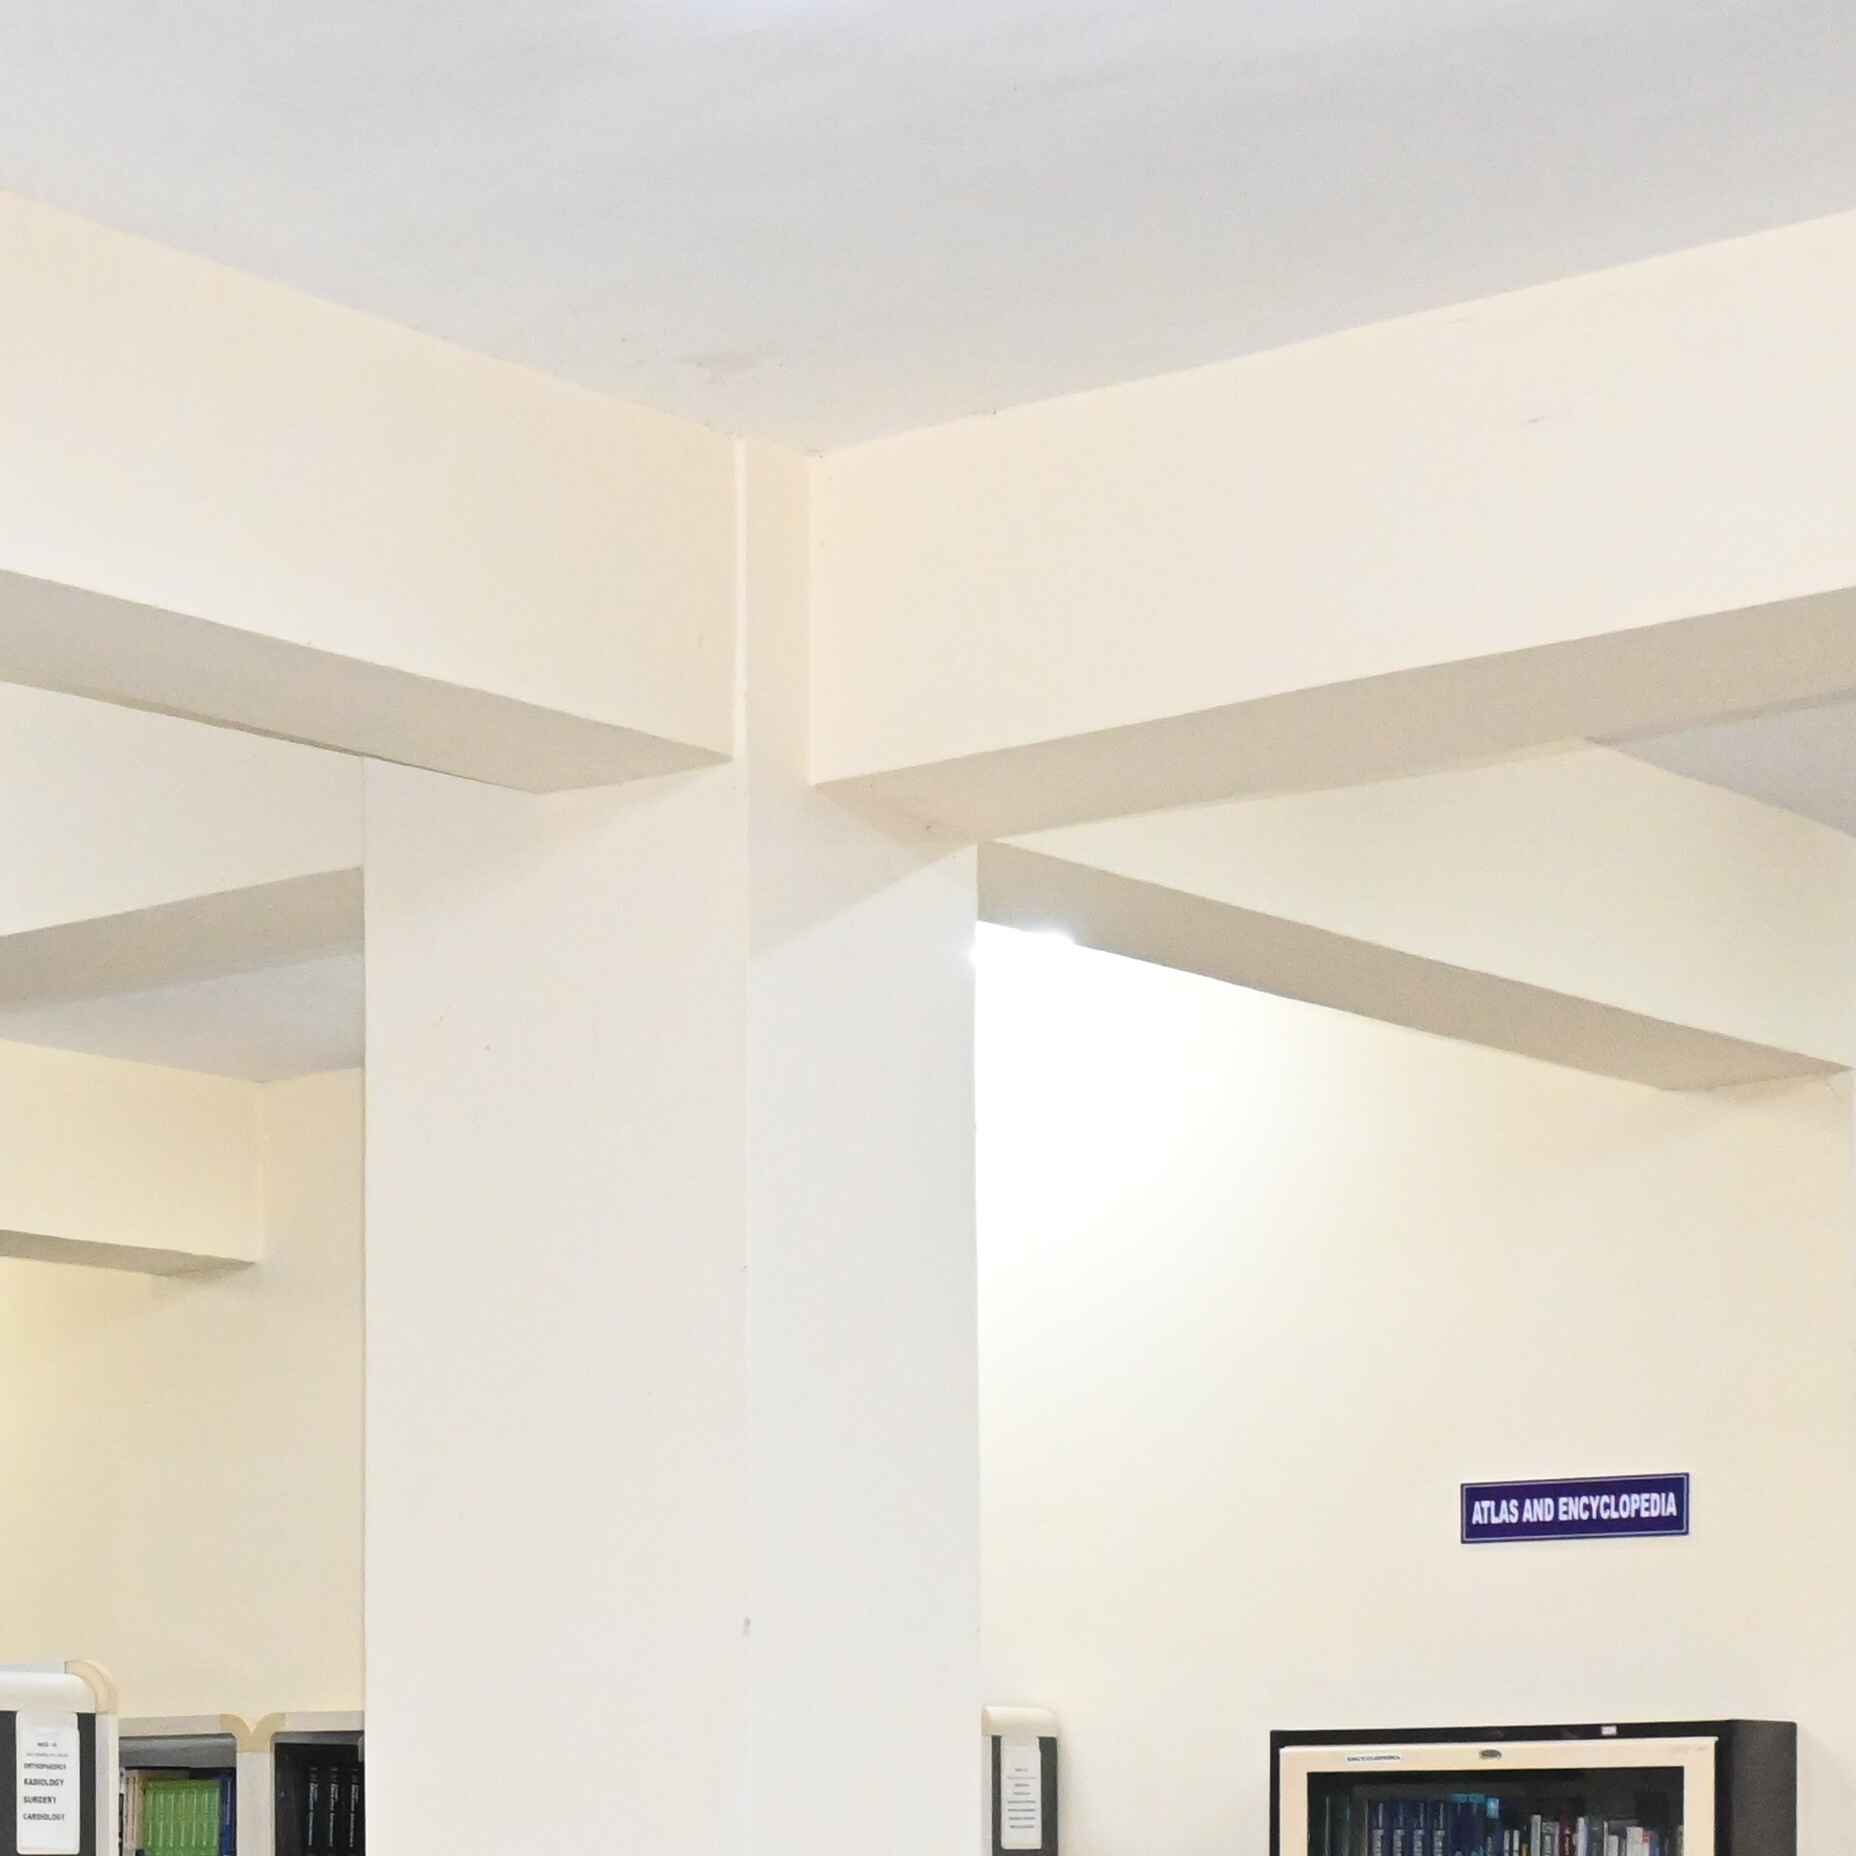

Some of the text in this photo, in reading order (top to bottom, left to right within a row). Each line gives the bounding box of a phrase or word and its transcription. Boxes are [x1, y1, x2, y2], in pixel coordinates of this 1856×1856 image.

[1472, 1492, 1677, 1524] ATLAS AND ENCYCLOPEDIA
[1371, 1829, 1383, 1856] Human
[1393, 1829, 1404, 1856] Human
[1412, 1829, 1424, 1856] Human
